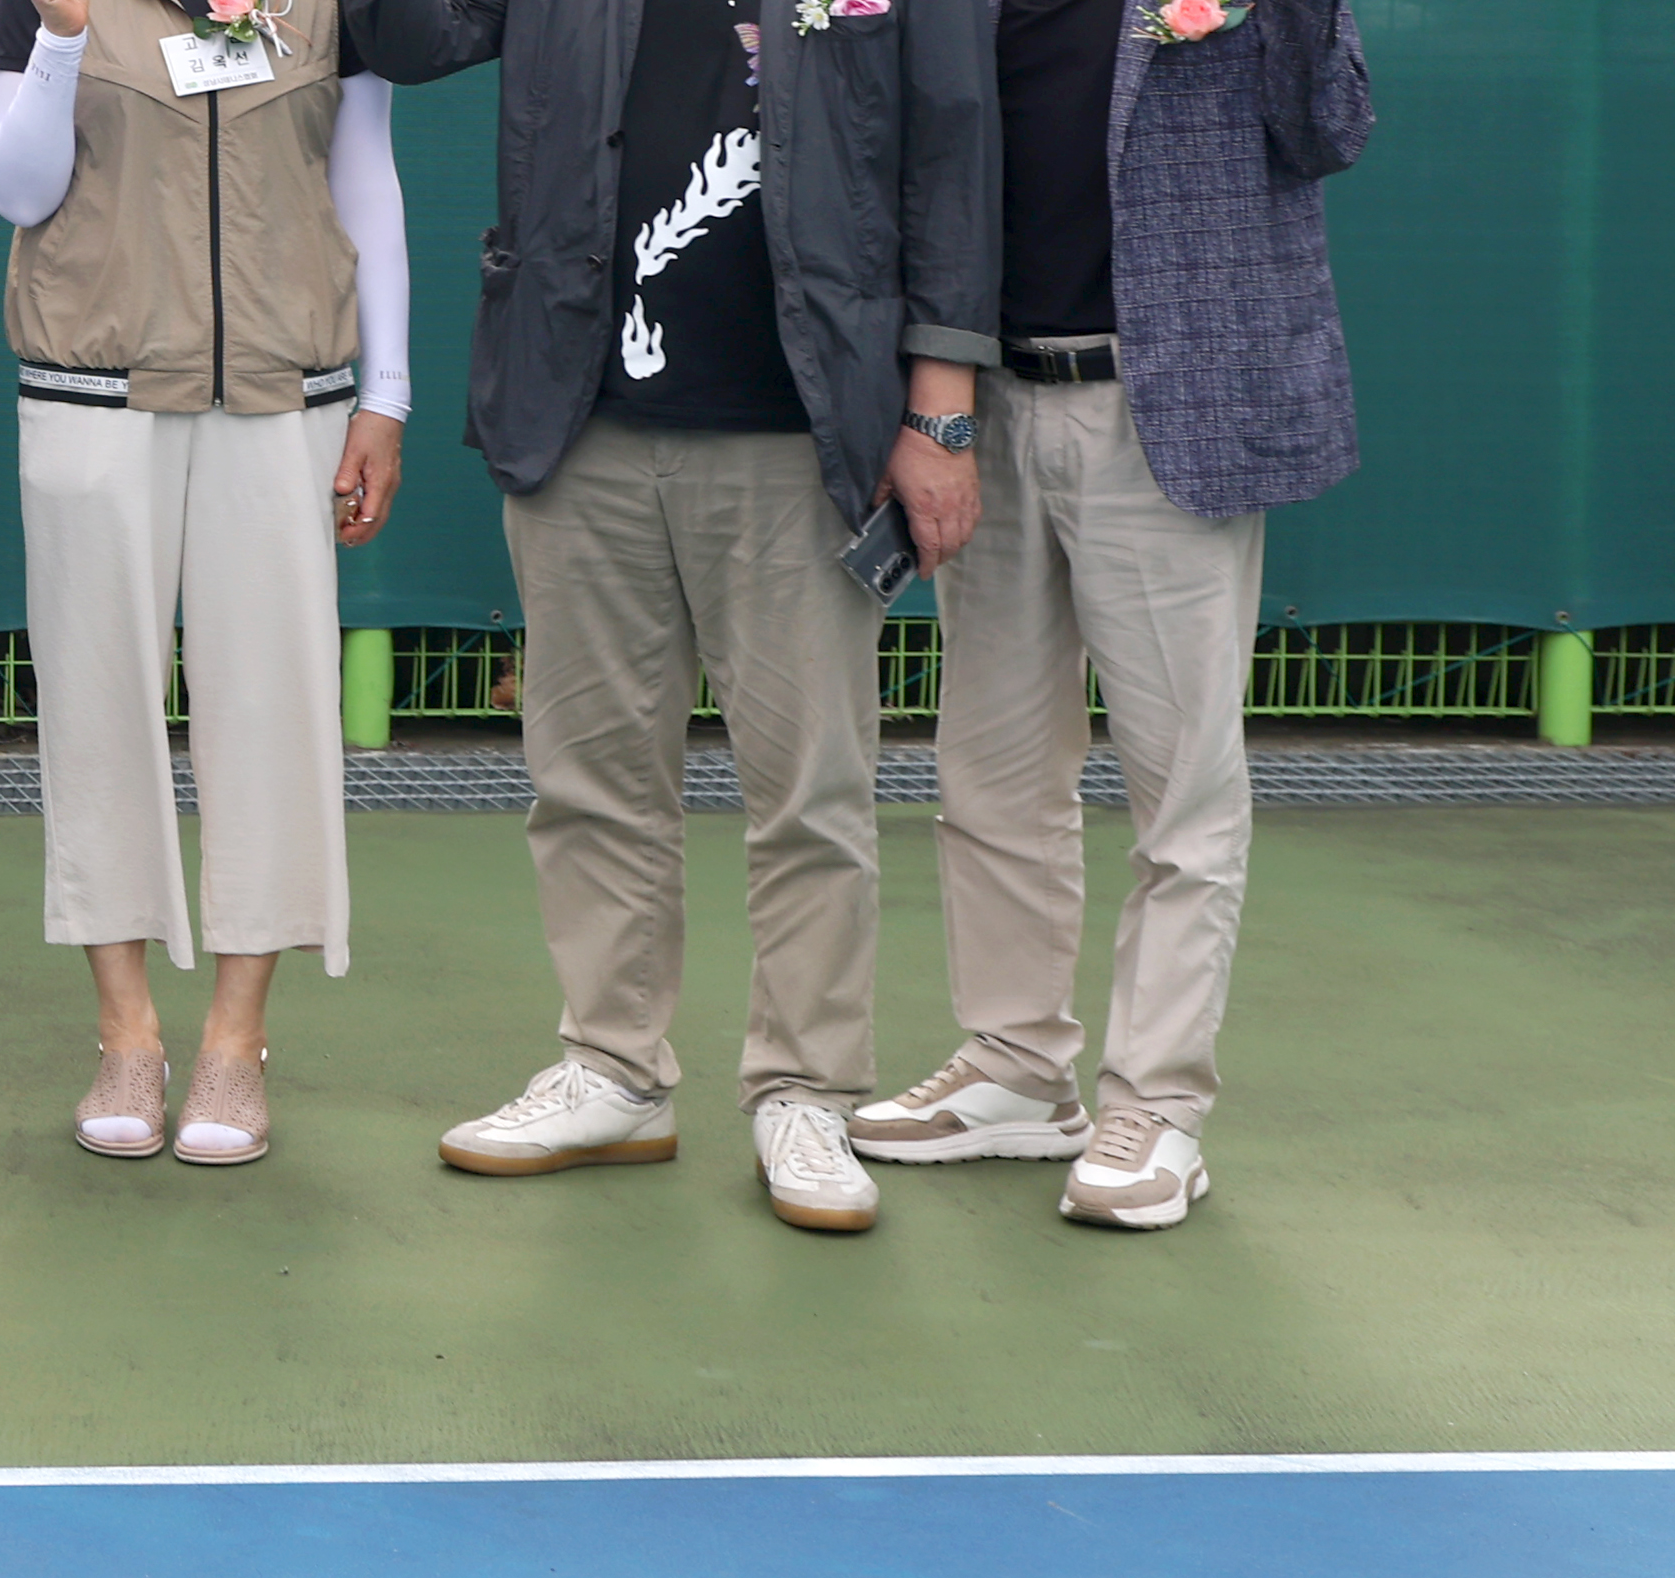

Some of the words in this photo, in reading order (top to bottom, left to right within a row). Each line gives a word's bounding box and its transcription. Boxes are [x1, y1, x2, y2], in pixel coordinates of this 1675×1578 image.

[48, 373, 67, 384] YOU
[68, 375, 103, 388] WANNA
[105, 379, 119, 390] BE
